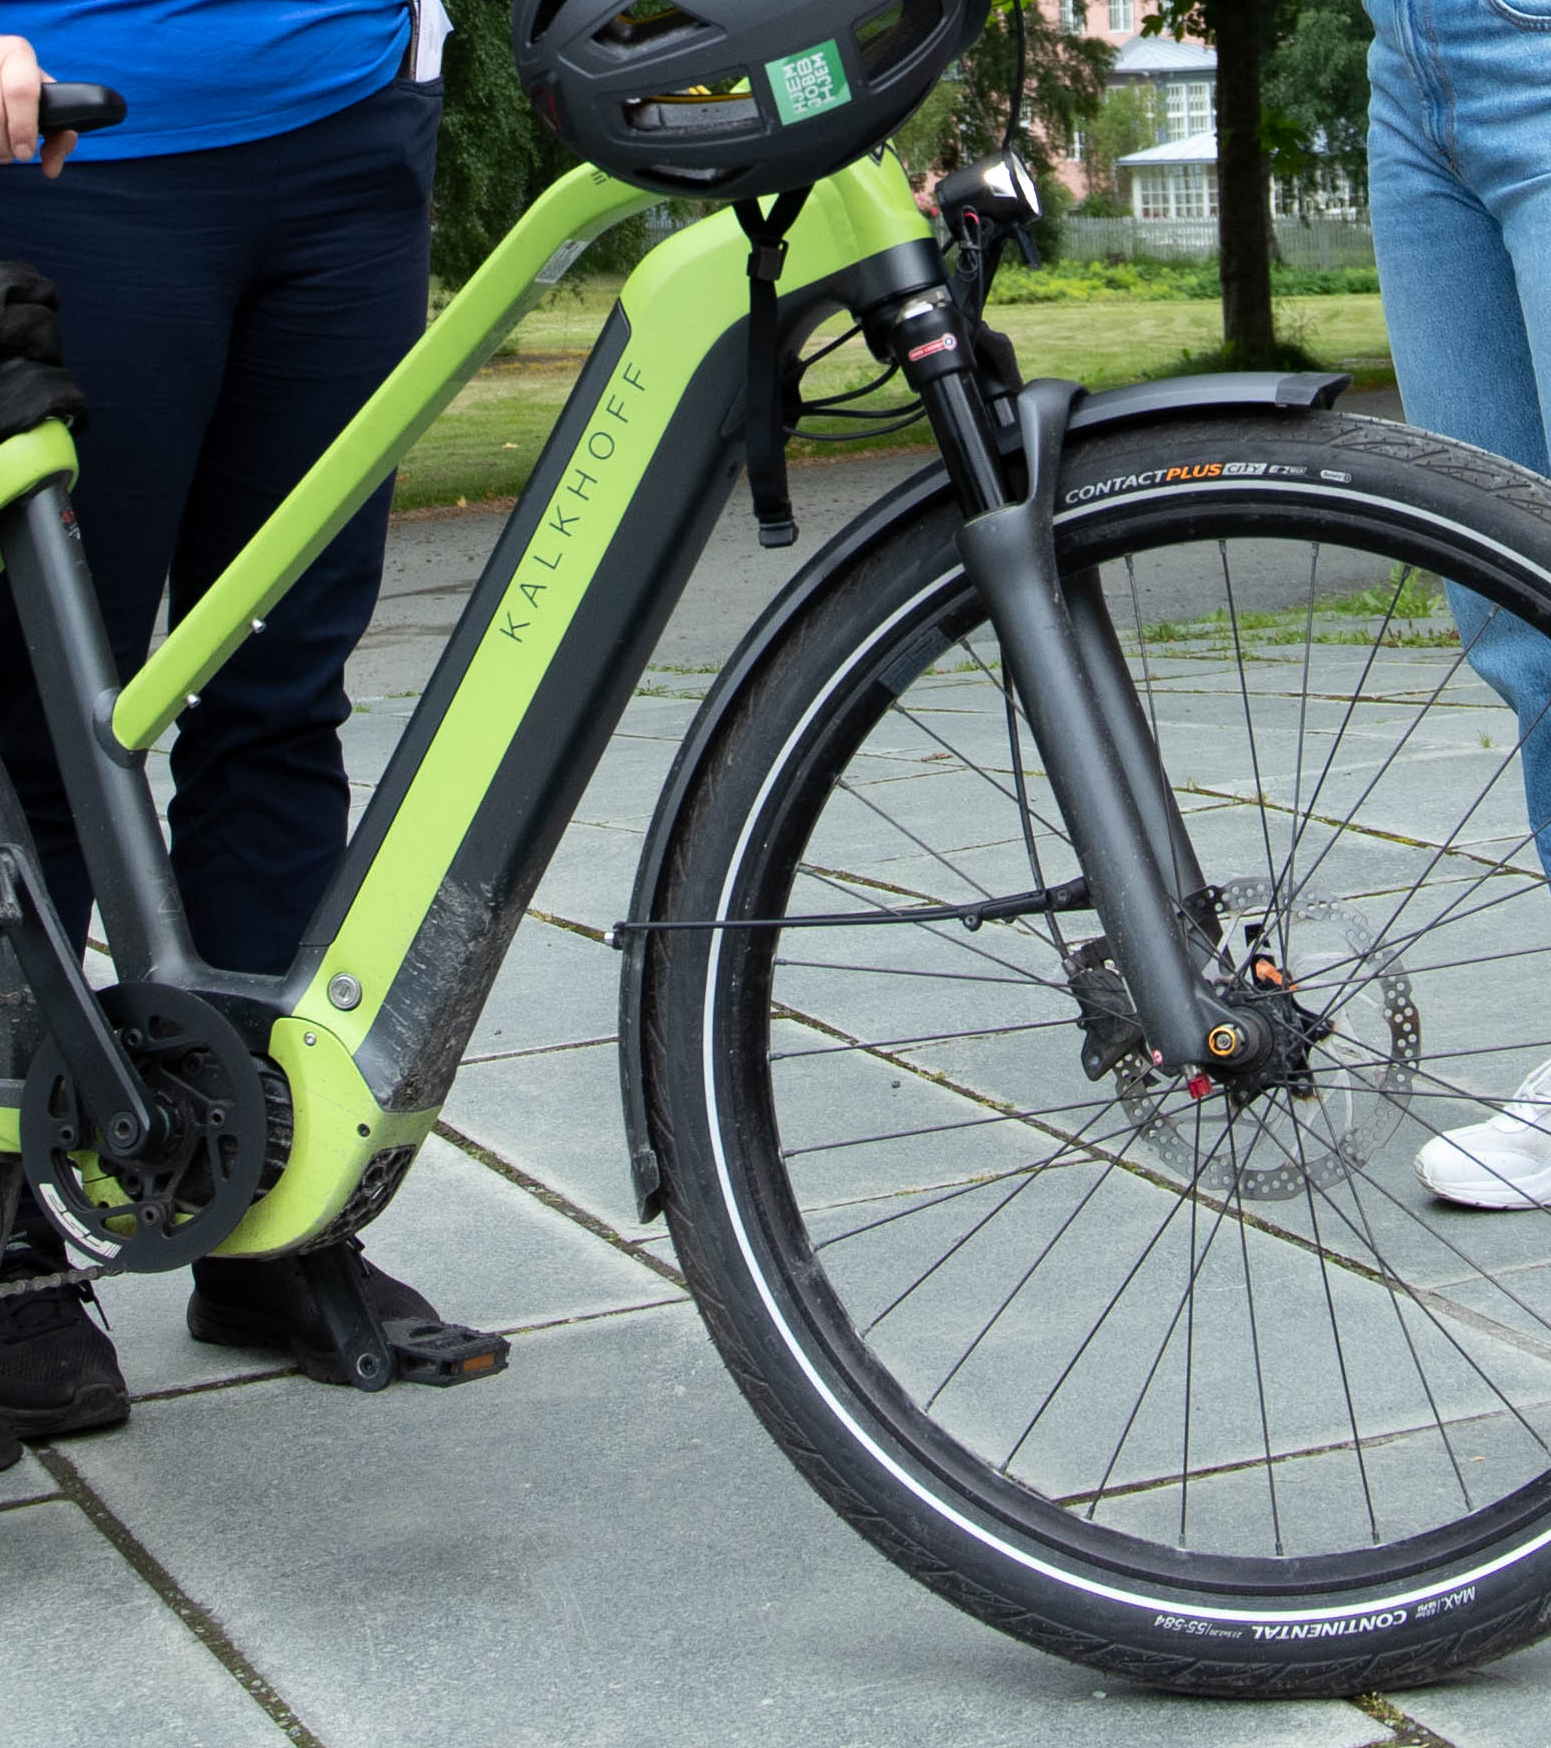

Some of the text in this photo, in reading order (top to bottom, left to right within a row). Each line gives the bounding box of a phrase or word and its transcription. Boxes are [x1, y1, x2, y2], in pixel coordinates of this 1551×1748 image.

[782, 63, 807, 113] HJEM
[796, 58, 822, 108] JOBB
[810, 51, 837, 102] HJEM
[499, 362, 646, 643] KALKHOFF
[1251, 1609, 1408, 1640] CONTINENTAL
